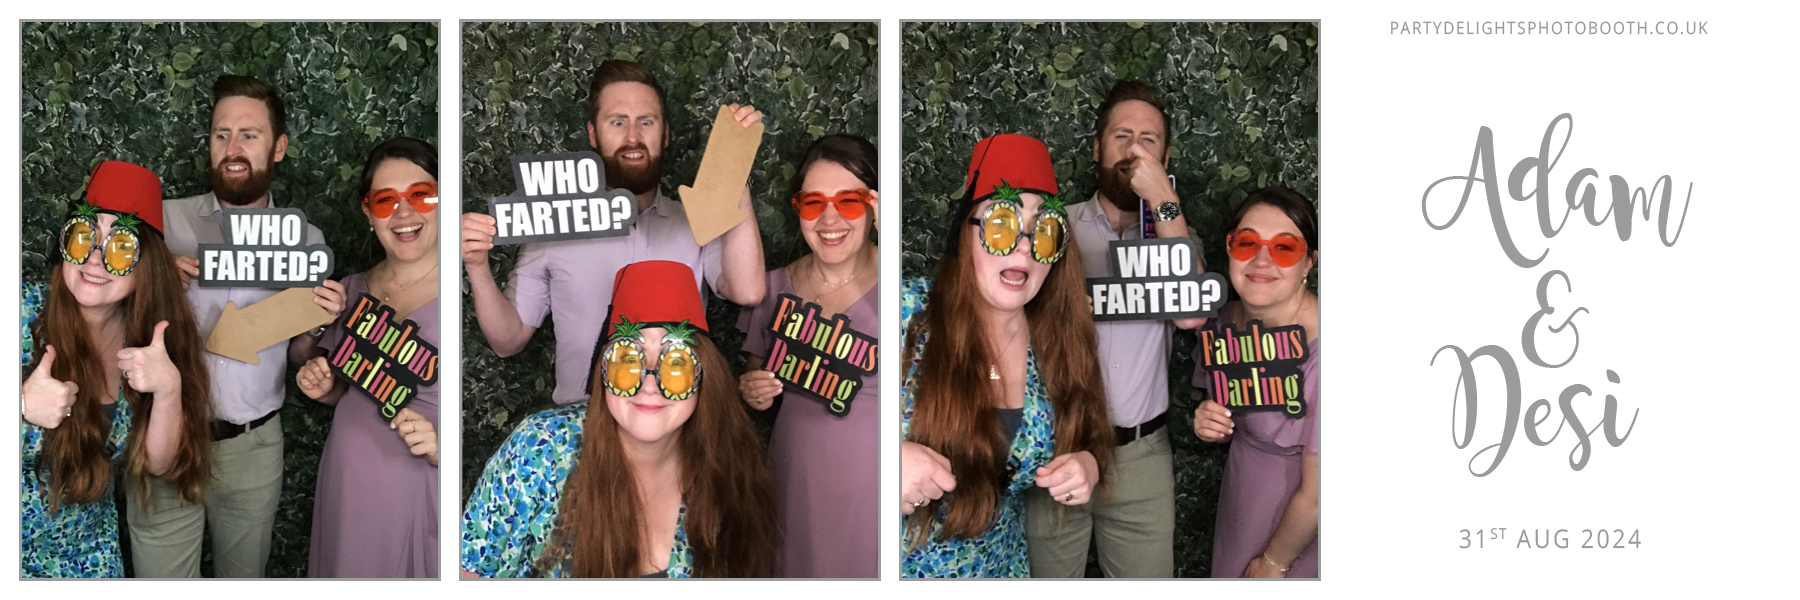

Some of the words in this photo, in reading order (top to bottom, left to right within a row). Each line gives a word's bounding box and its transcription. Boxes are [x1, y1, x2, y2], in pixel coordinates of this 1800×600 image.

[519, 158, 599, 196] WHO
[230, 214, 302, 247] WHO
[494, 196, 632, 238] FARTED?
[204, 250, 328, 282] FARTED?
[1116, 243, 1191, 278] WHO
[1092, 279, 1221, 315] FARTED?
[345, 296, 438, 381] Fabulous
[772, 297, 878, 372] Fabulous
[1201, 324, 1304, 366] Fabulous
[332, 334, 412, 418] Darling
[764, 338, 857, 413] Darling
[1213, 367, 1302, 414] Darling
